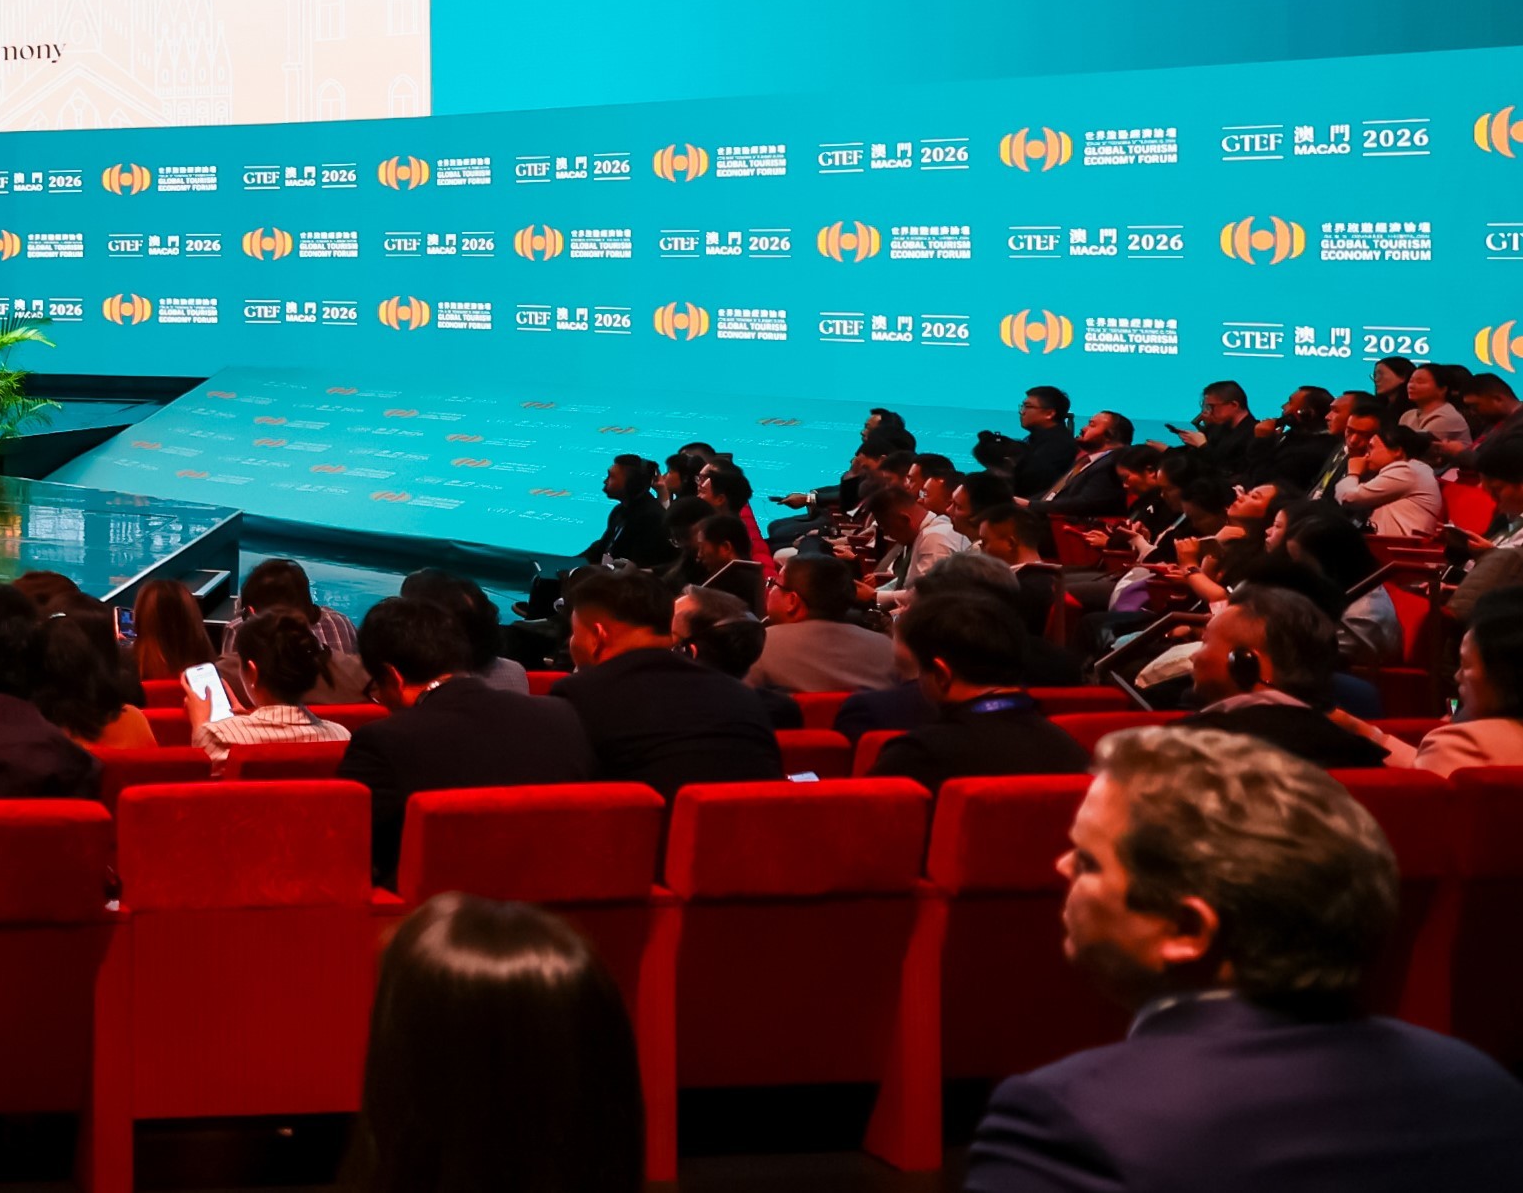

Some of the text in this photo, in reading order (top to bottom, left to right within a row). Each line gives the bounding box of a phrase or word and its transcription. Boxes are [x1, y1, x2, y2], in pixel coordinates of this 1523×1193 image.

[1222, 124, 1430, 153] GTEF 澳門 2026
[1084, 144, 1177, 156] GLOBAL TOURISM
[1294, 144, 1350, 155] MACAO
[1084, 154, 1177, 165] ECONOMY FORUM
[49, 176, 82, 188] 2026
[1321, 240, 1431, 249] GLOBAL TOURISM
[1321, 251, 1431, 260] ECONOMY FORUM
[872, 315, 912, 331] 澳門
[922, 322, 968, 339] 2026
[872, 332, 912, 342] MACAO
